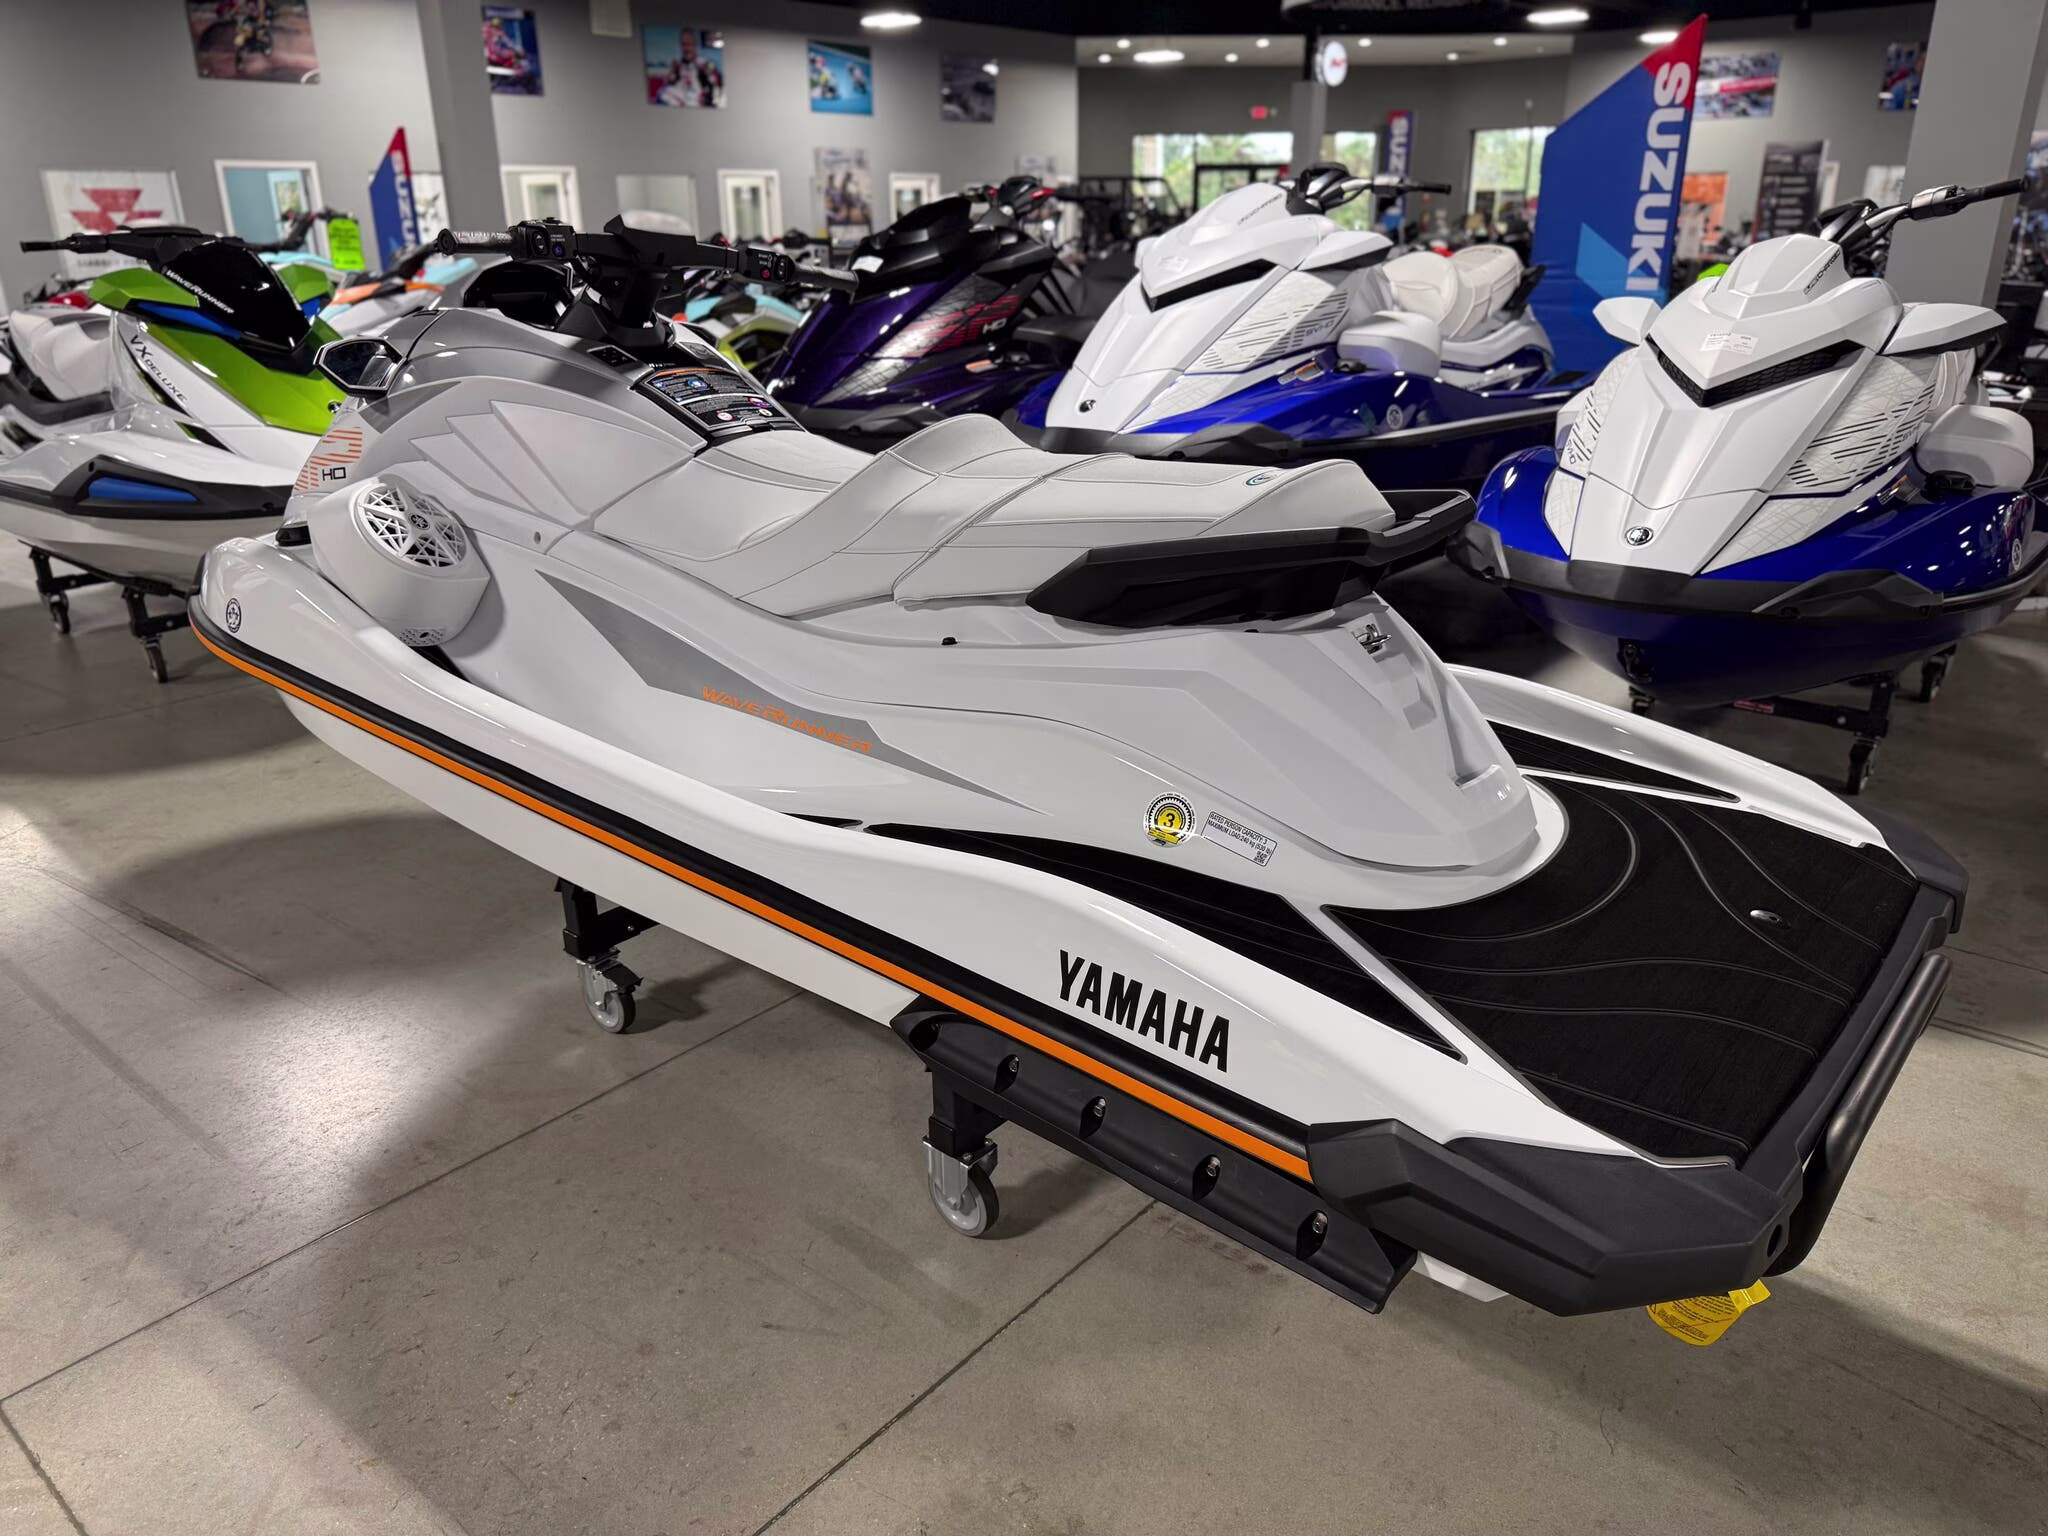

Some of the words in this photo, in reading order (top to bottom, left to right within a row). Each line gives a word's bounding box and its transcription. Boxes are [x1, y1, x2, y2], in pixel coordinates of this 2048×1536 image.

[1625, 61, 1691, 292] SUZUKI
[982, 317, 1007, 335] HO
[322, 466, 347, 481] HO
[1163, 812, 1176, 828] 3
[1208, 820, 1229, 834] MAXIMUM
[1209, 813, 1224, 824] RATED
[1223, 819, 1242, 833] PERSON
[1059, 949, 1230, 1073] YAMAHA
